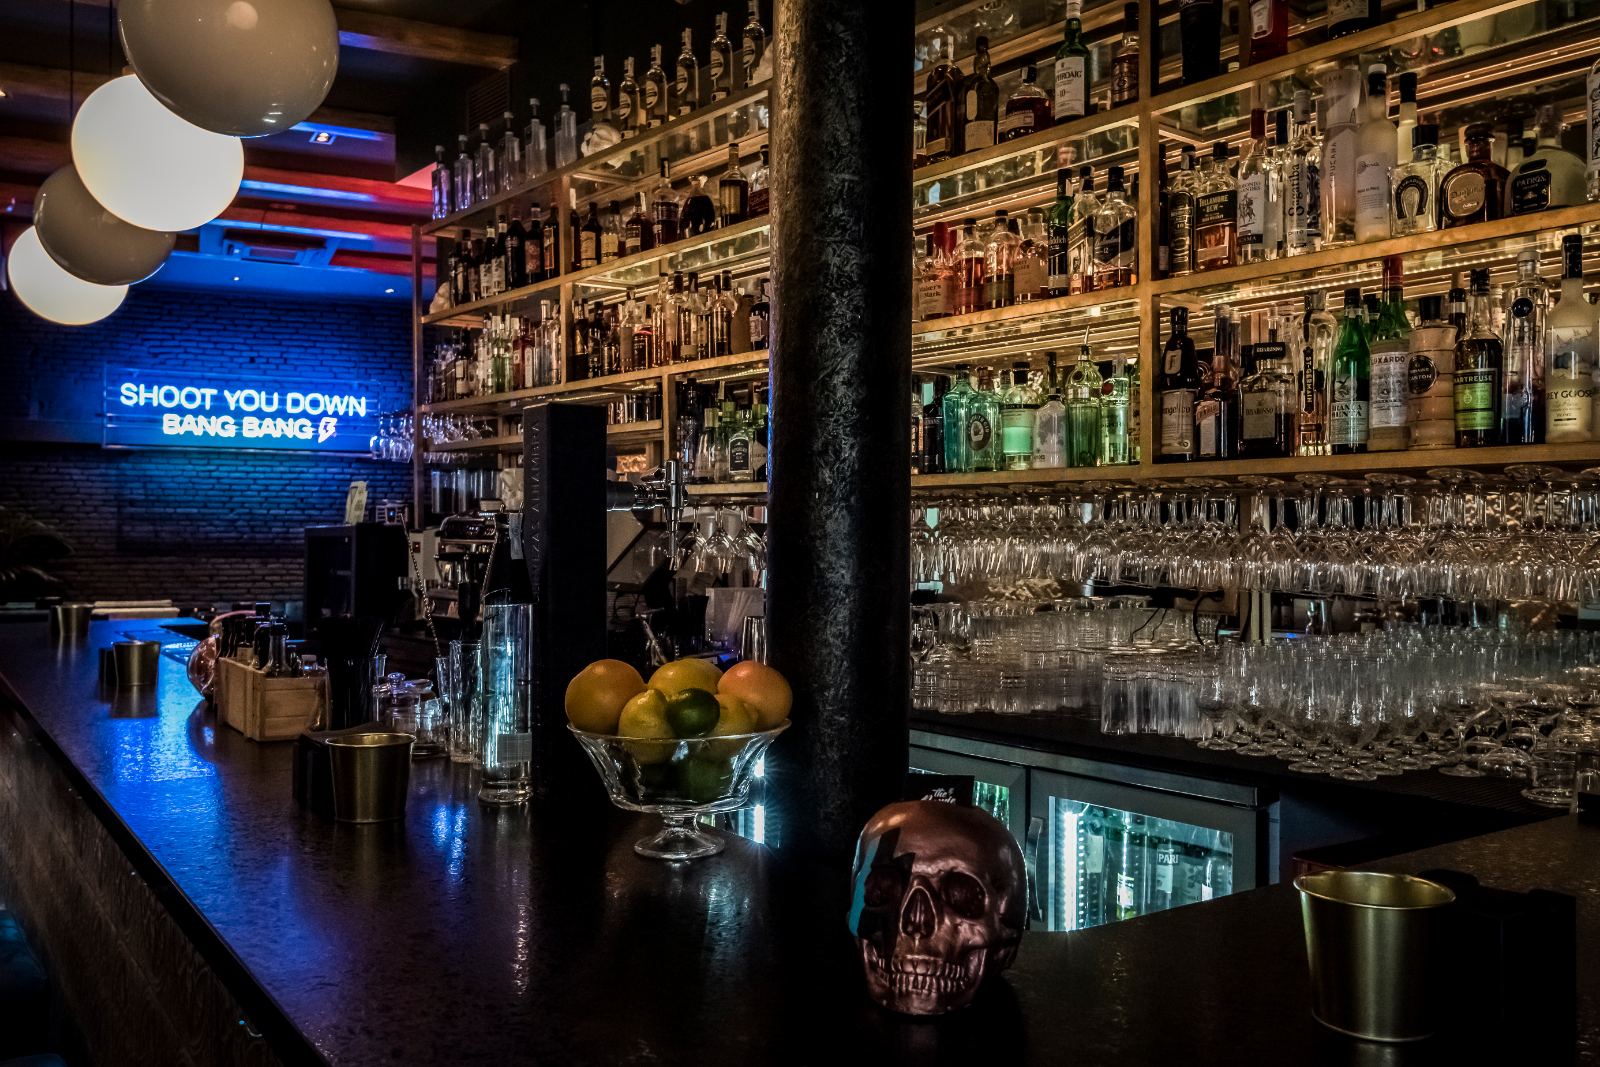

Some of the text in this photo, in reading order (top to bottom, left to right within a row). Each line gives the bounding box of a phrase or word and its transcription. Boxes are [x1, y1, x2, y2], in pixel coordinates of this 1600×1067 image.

[1288, 164, 1305, 217] Sagatiba
[119, 382, 367, 418] SHOOT YOU DOWN
[1306, 356, 1314, 403] ST-GERMAIN
[162, 412, 313, 440] BANG BANG
